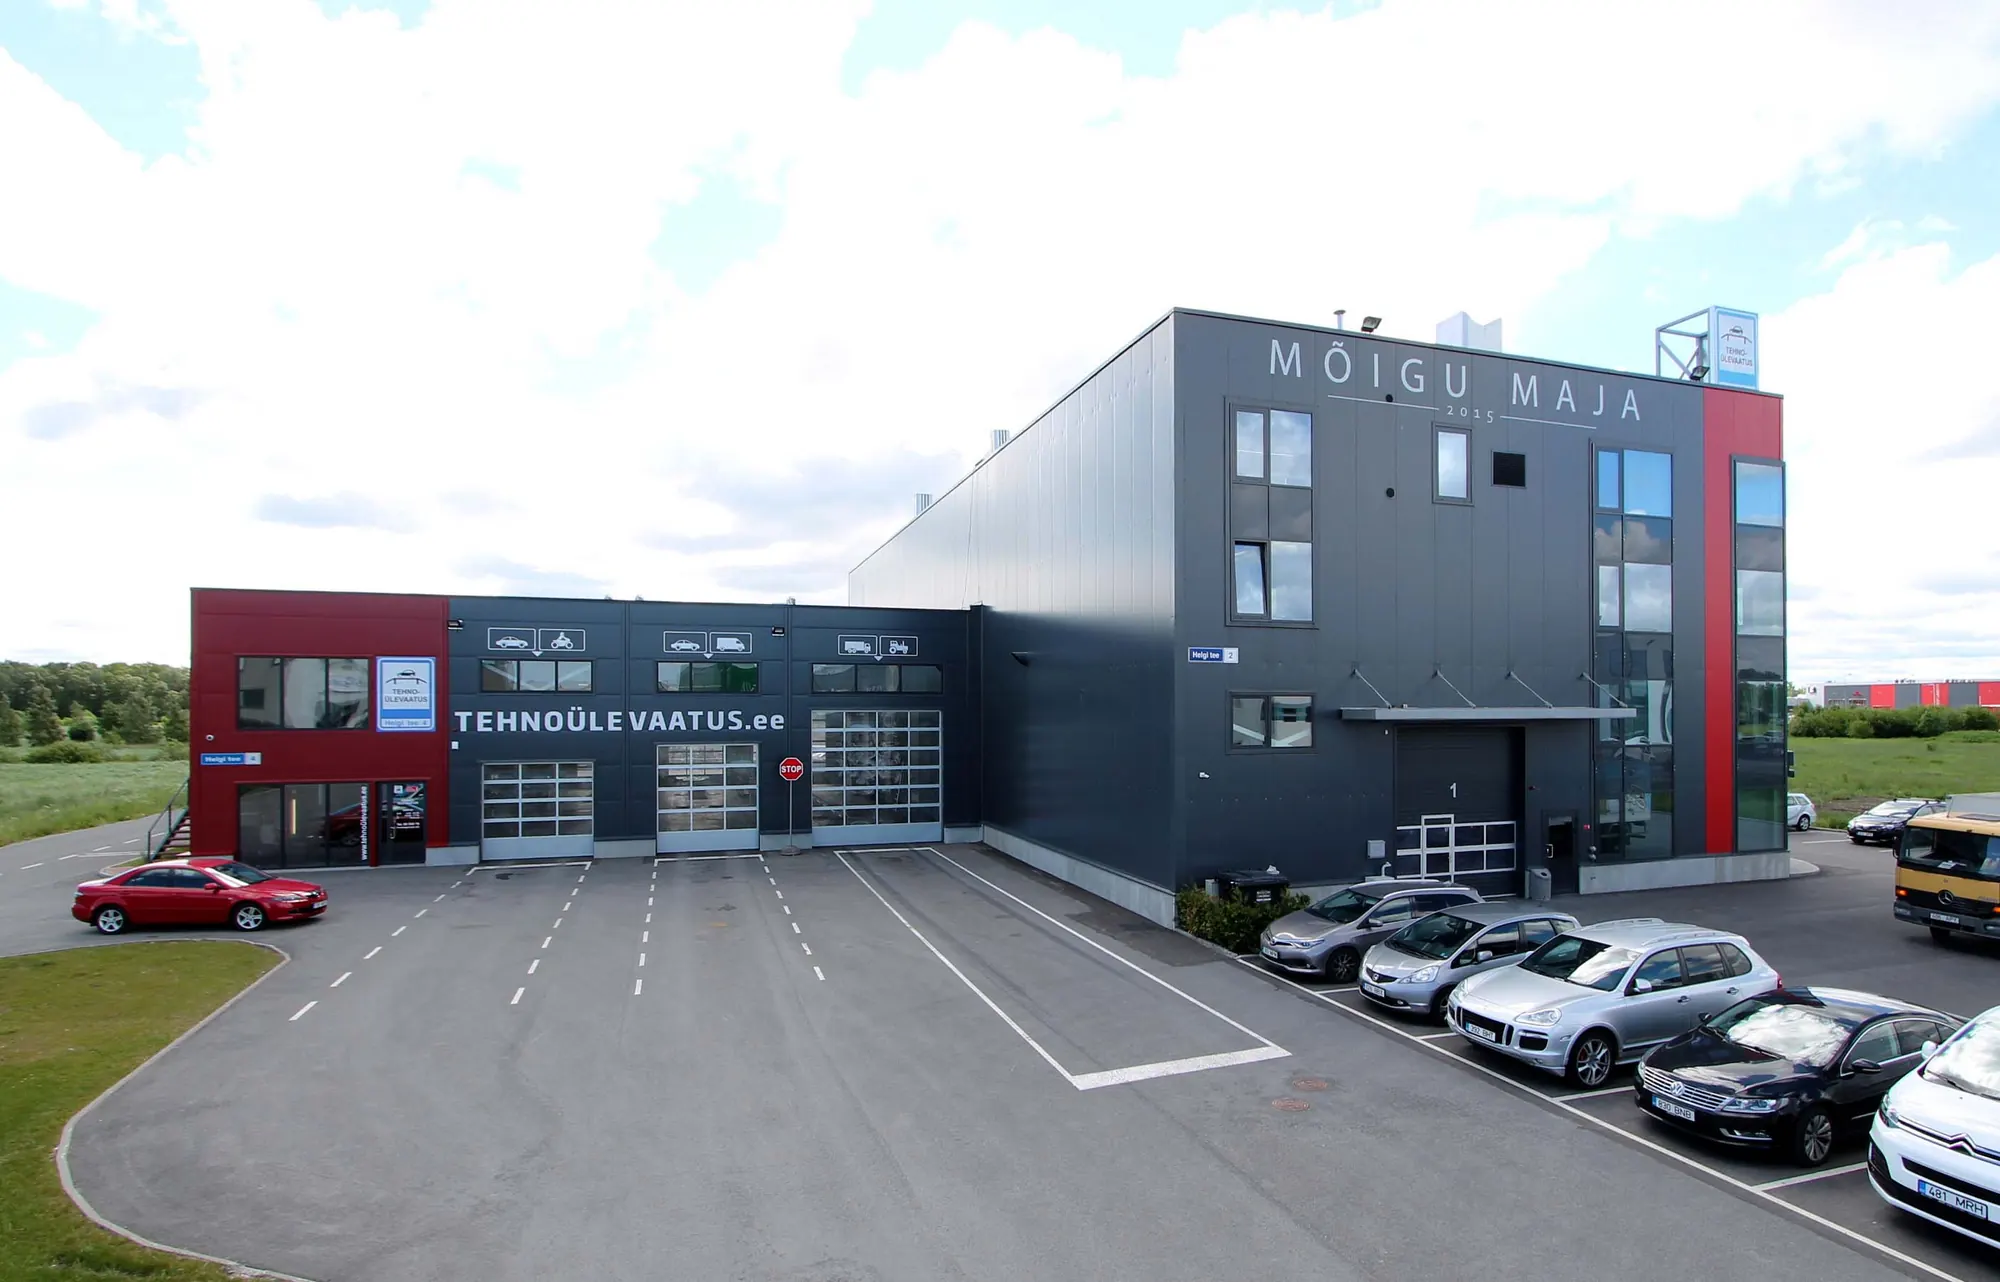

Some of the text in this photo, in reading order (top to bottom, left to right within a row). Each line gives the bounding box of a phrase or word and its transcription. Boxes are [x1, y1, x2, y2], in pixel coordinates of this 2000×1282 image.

[1726, 346, 1748, 356] TEHNO-
[1721, 354, 1753, 367] ÜLEVAATUS
[1270, 340, 1641, 421] MÕIGU MAJA
[1446, 405, 1494, 424] 2015
[1192, 651, 1233, 660] Helgi tee 2
[384, 695, 428, 703] ÜLEVAATUS
[781, 763, 802, 774] STOP
[1450, 782, 1457, 798] 1
[1674, 1106, 1692, 1119] BNB
[1929, 1187, 1984, 1215] 481 MRH
